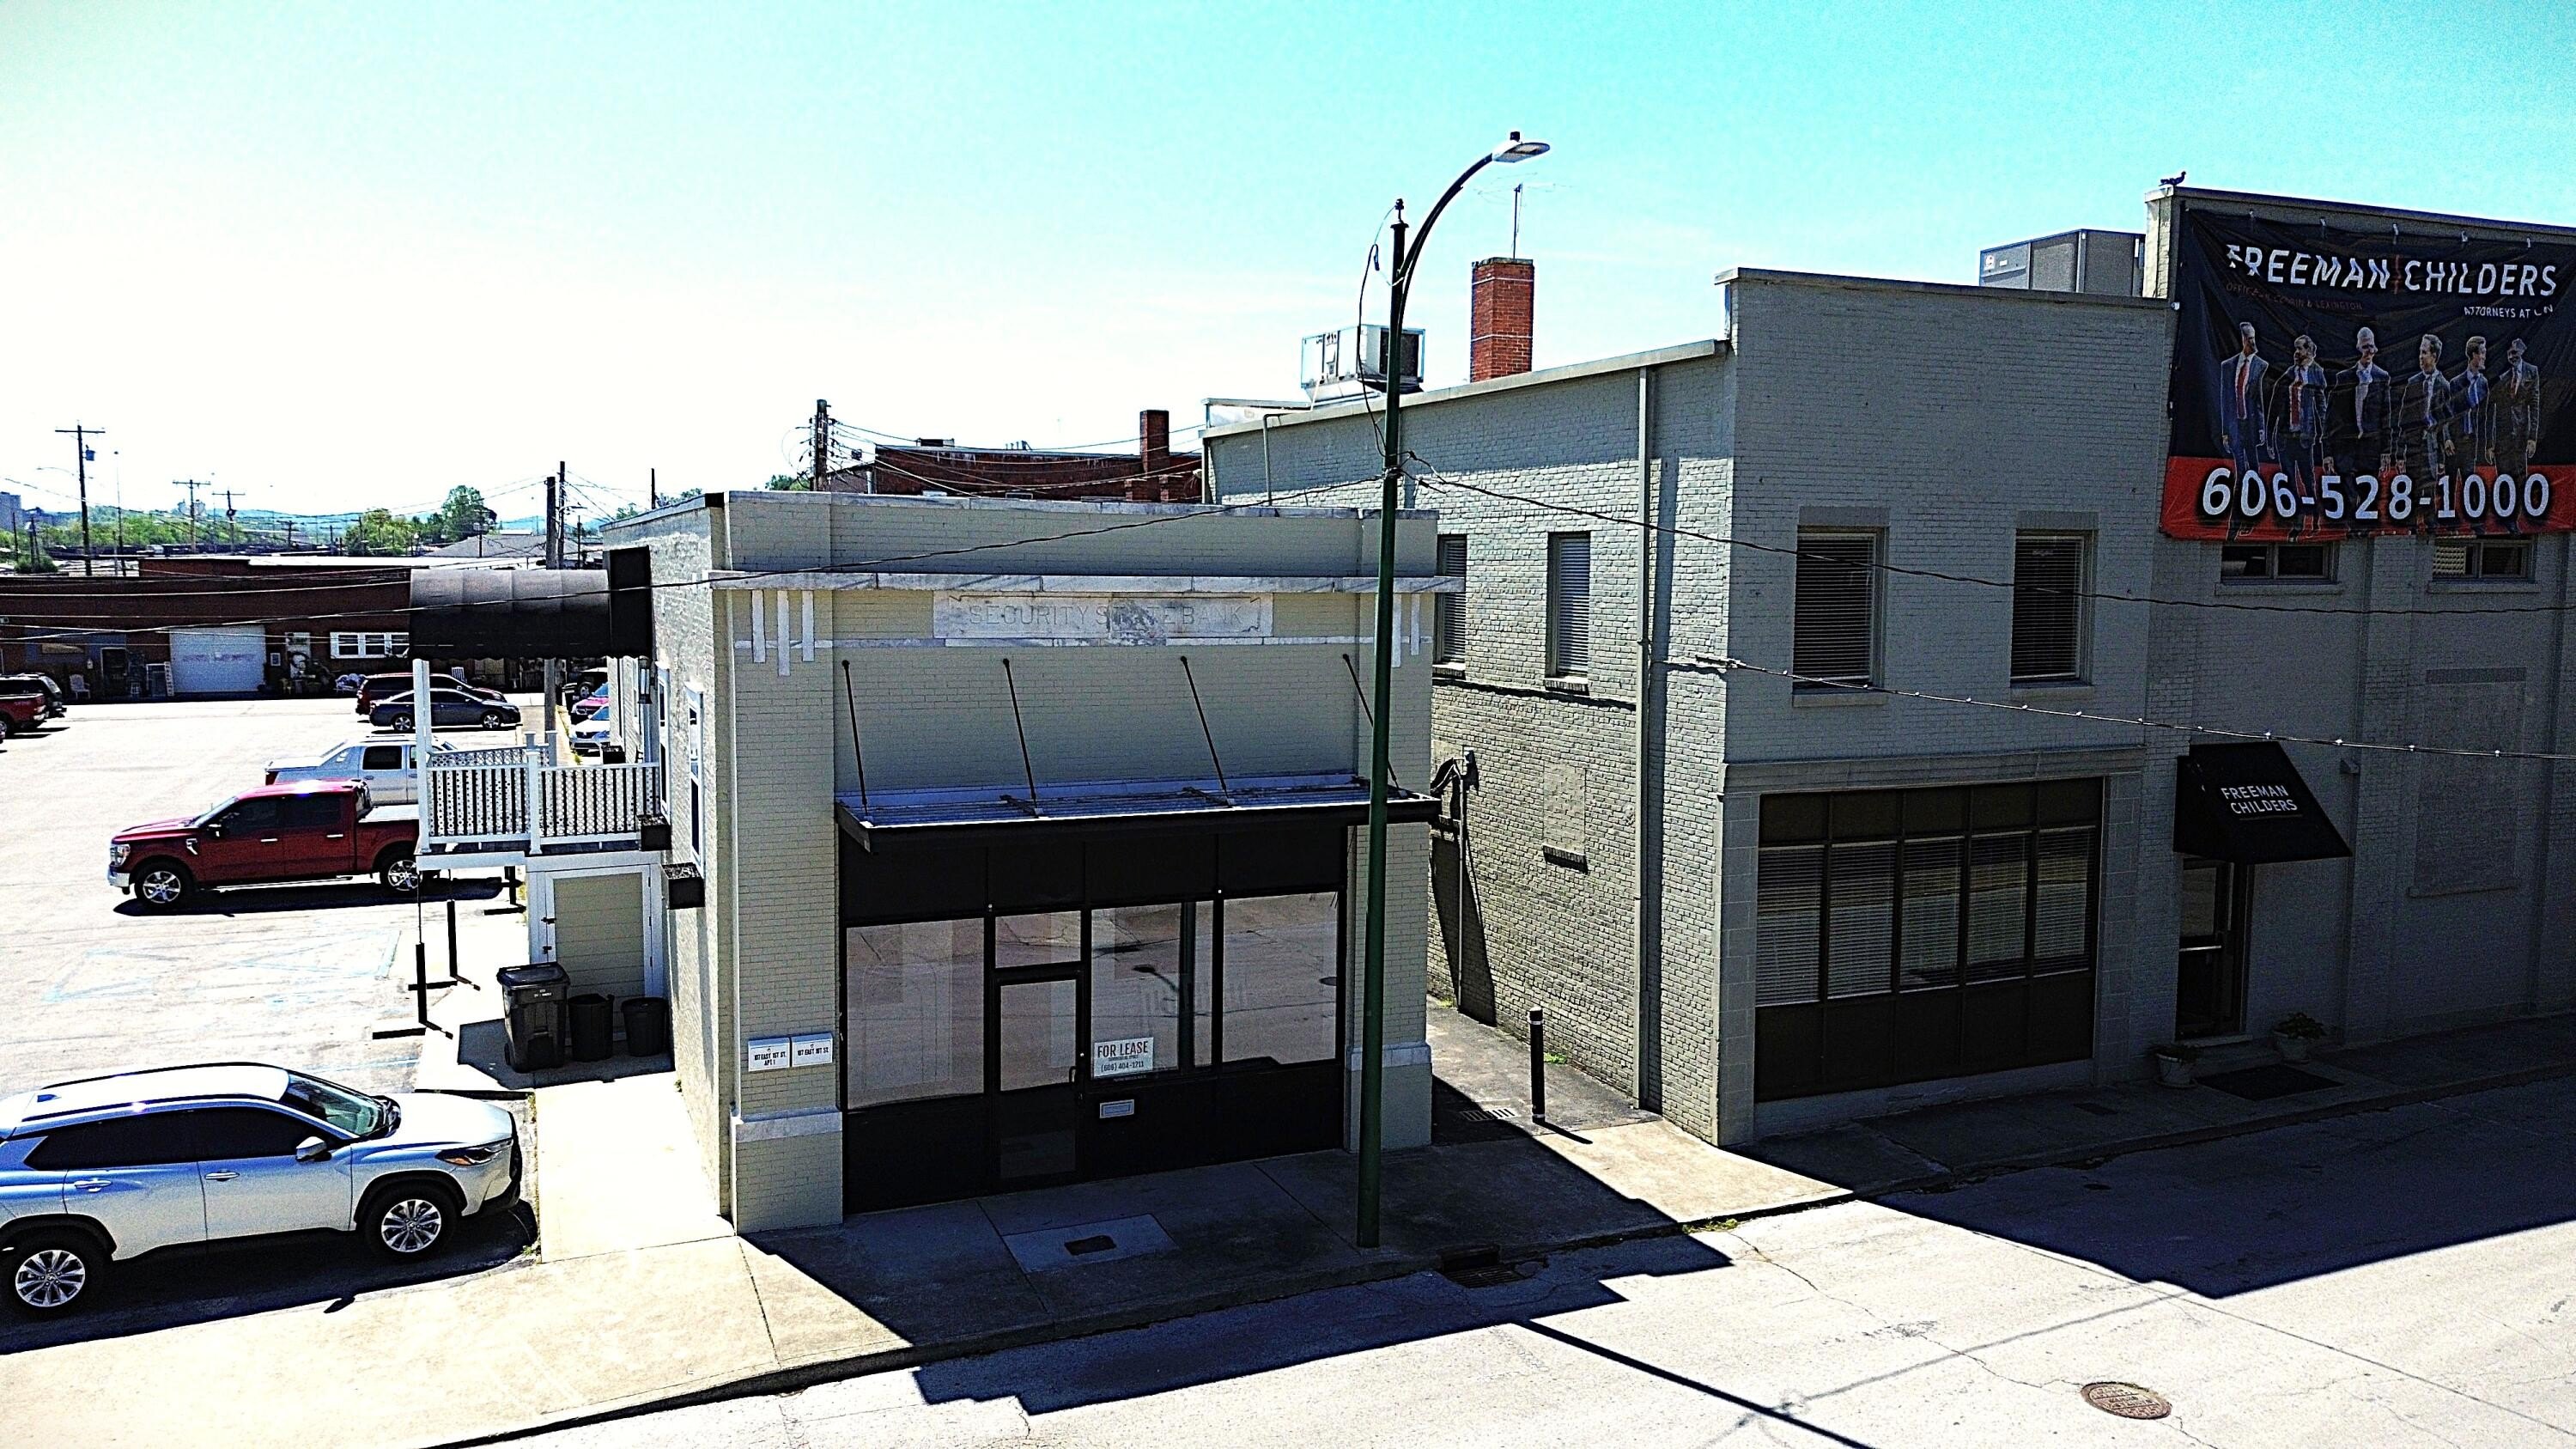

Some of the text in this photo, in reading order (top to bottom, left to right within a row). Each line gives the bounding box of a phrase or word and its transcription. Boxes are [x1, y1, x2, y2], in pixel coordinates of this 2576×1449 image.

[2226, 244, 2557, 297] FREEMAN CHILDERS
[2464, 306, 2516, 319] ATTORNEYS
[2518, 308, 2531, 319] AT
[2202, 467, 2549, 520] 606-528-1000
[969, 605, 1242, 625] SECURITY STTE BANK
[2221, 785, 2289, 800] FREEMAN
[2230, 799, 2298, 814] CHILDERS
[1097, 1044, 1116, 1058] FOR
[1120, 1041, 1148, 1056] LEASE
